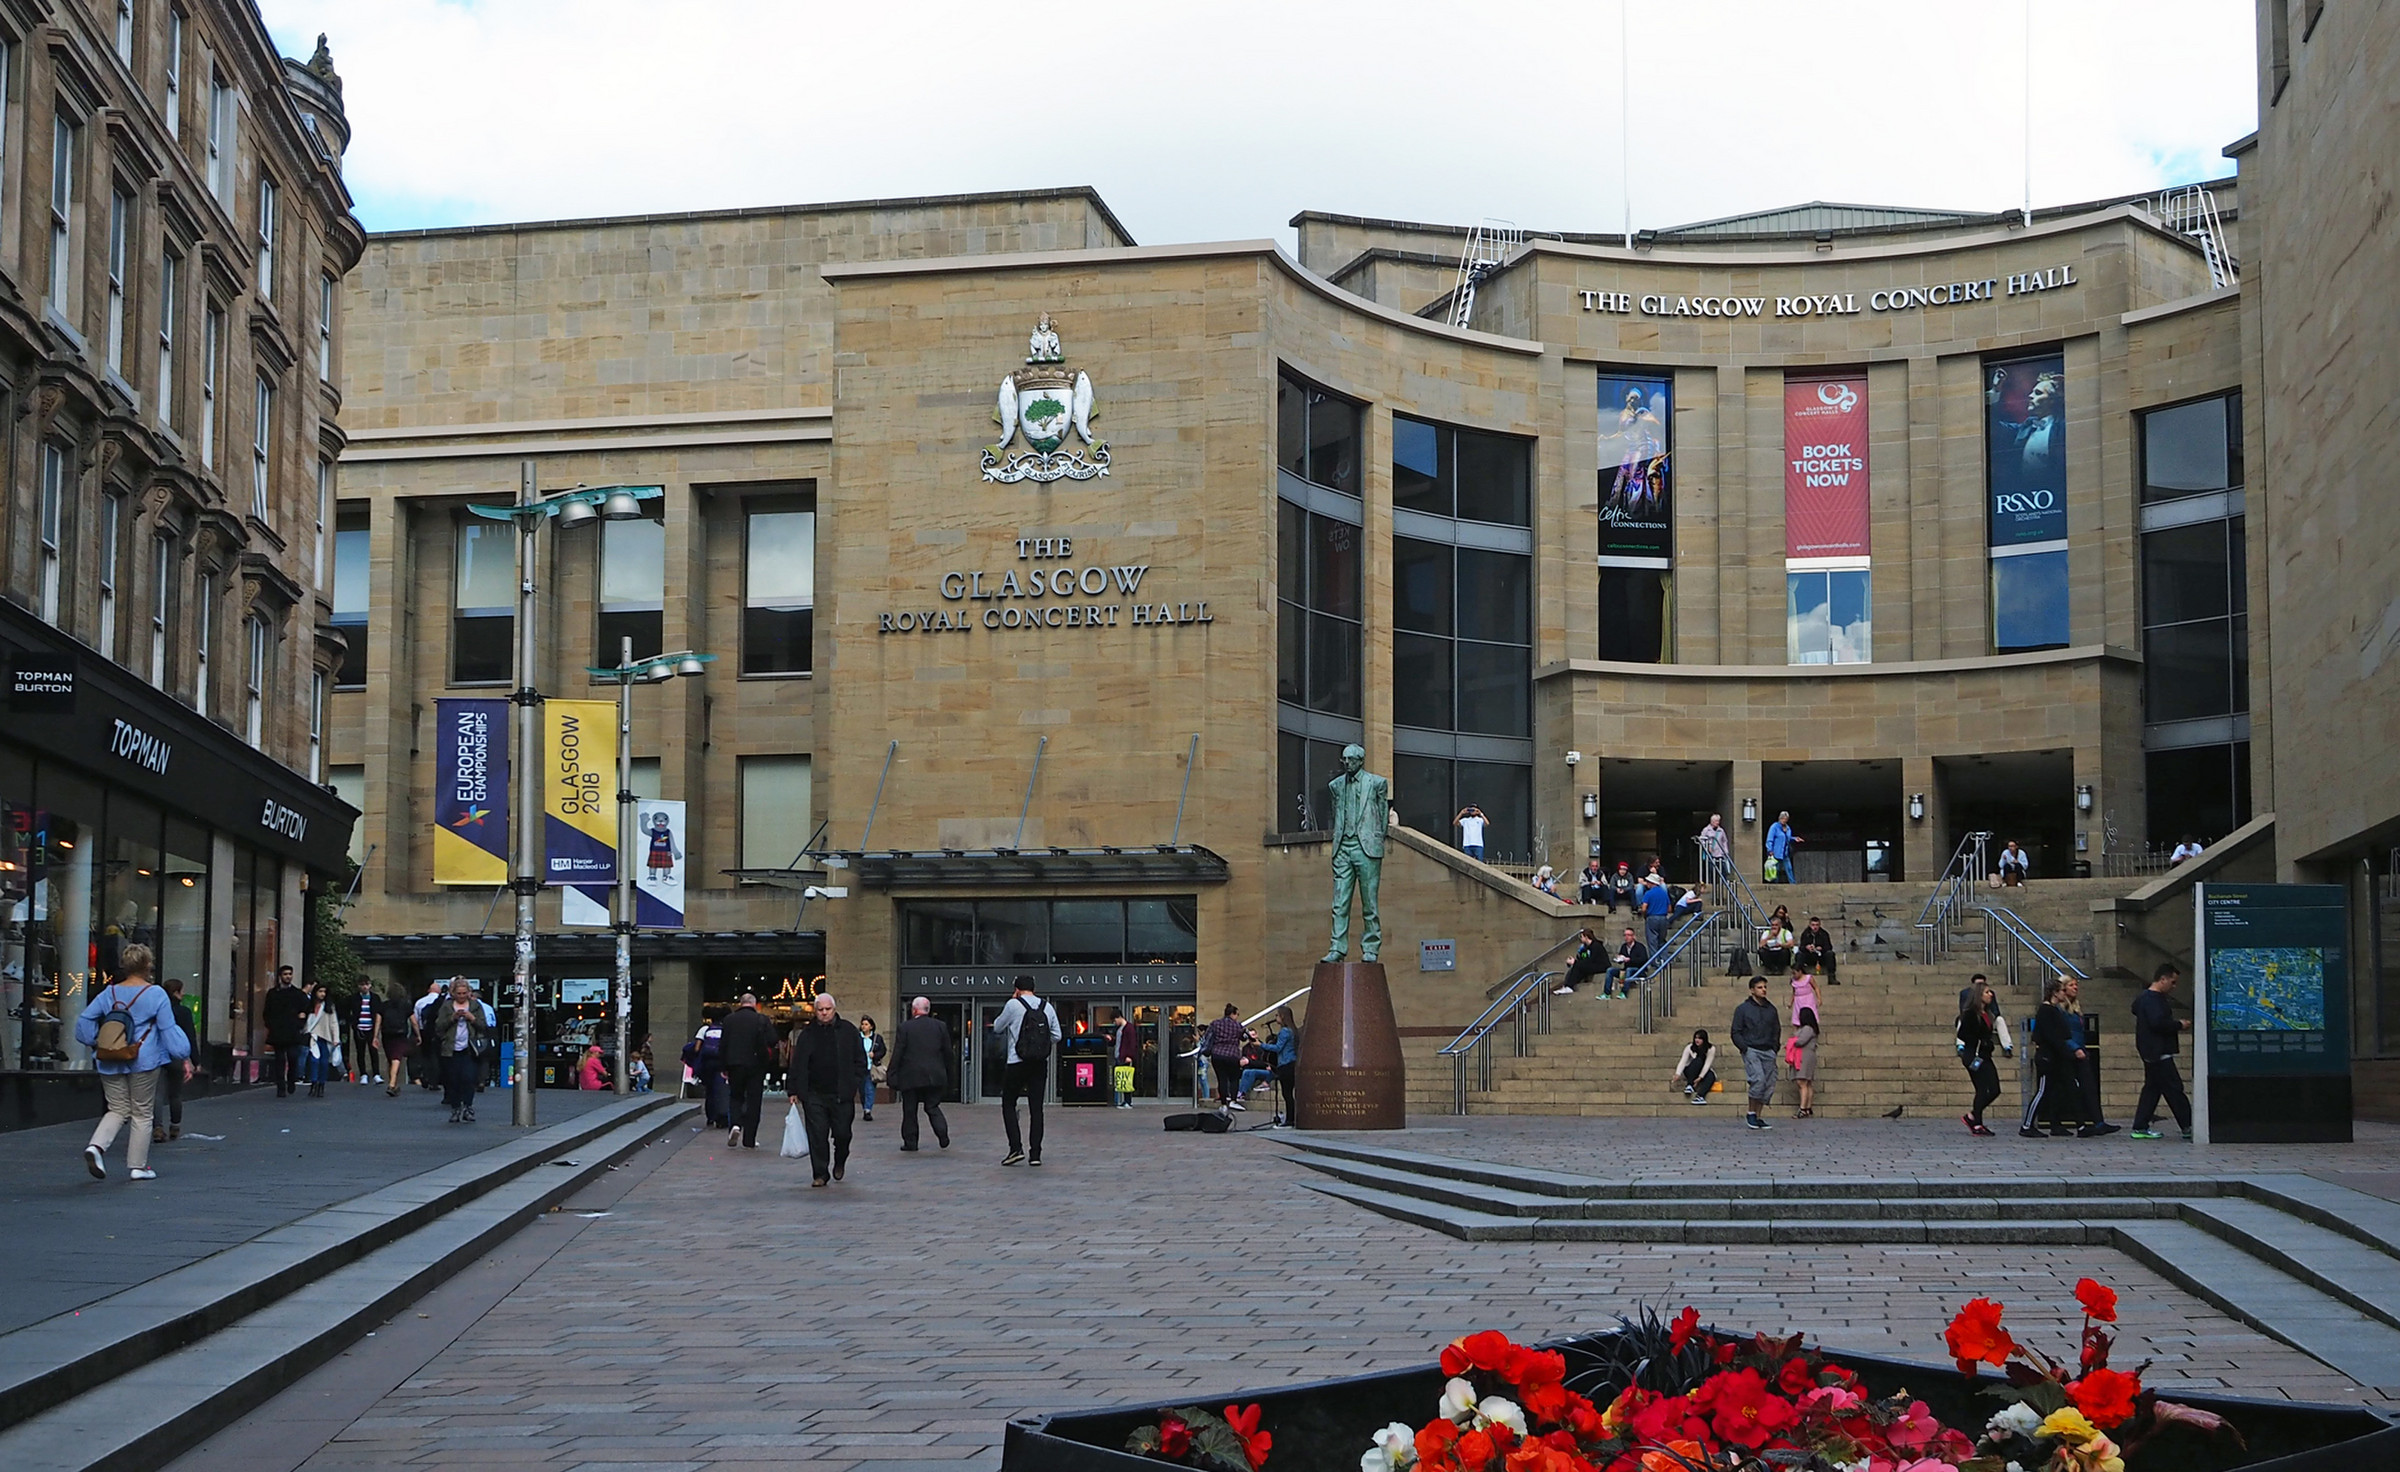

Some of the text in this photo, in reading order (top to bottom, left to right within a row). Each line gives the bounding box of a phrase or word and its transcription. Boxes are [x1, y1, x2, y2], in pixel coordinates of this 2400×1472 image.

[1579, 265, 2078, 318] THE GLASGOW ROYAL CONCERT HALL
[1803, 443, 1851, 459] BOOK
[1024, 468, 1060, 480] GLASGOW
[1061, 462, 1098, 478] FLOURISH
[1791, 457, 1863, 473] TICKETS
[1806, 473, 1849, 487] NOW
[1995, 489, 2054, 514] RSNO
[1598, 504, 1632, 528] Celtic
[1613, 521, 1667, 529] CONNECTIONS
[1015, 537, 1074, 559] THE
[940, 565, 1149, 600] GLASGOW
[878, 602, 1214, 634] ROYAL CONCERT HALL
[15, 671, 73, 682] TOPMAN
[15, 683, 72, 693] BURTON
[110, 718, 171, 775] TOPMAN
[457, 712, 475, 801] EUROPEAN
[475, 712, 487, 801] CHAMPIONSHIPS
[561, 714, 579, 814] GLASGOW
[582, 773, 600, 814] 2018
[261, 798, 308, 842] BURTON
[552, 859, 570, 868] HM
[1060, 975, 1178, 985] GALLERIES
